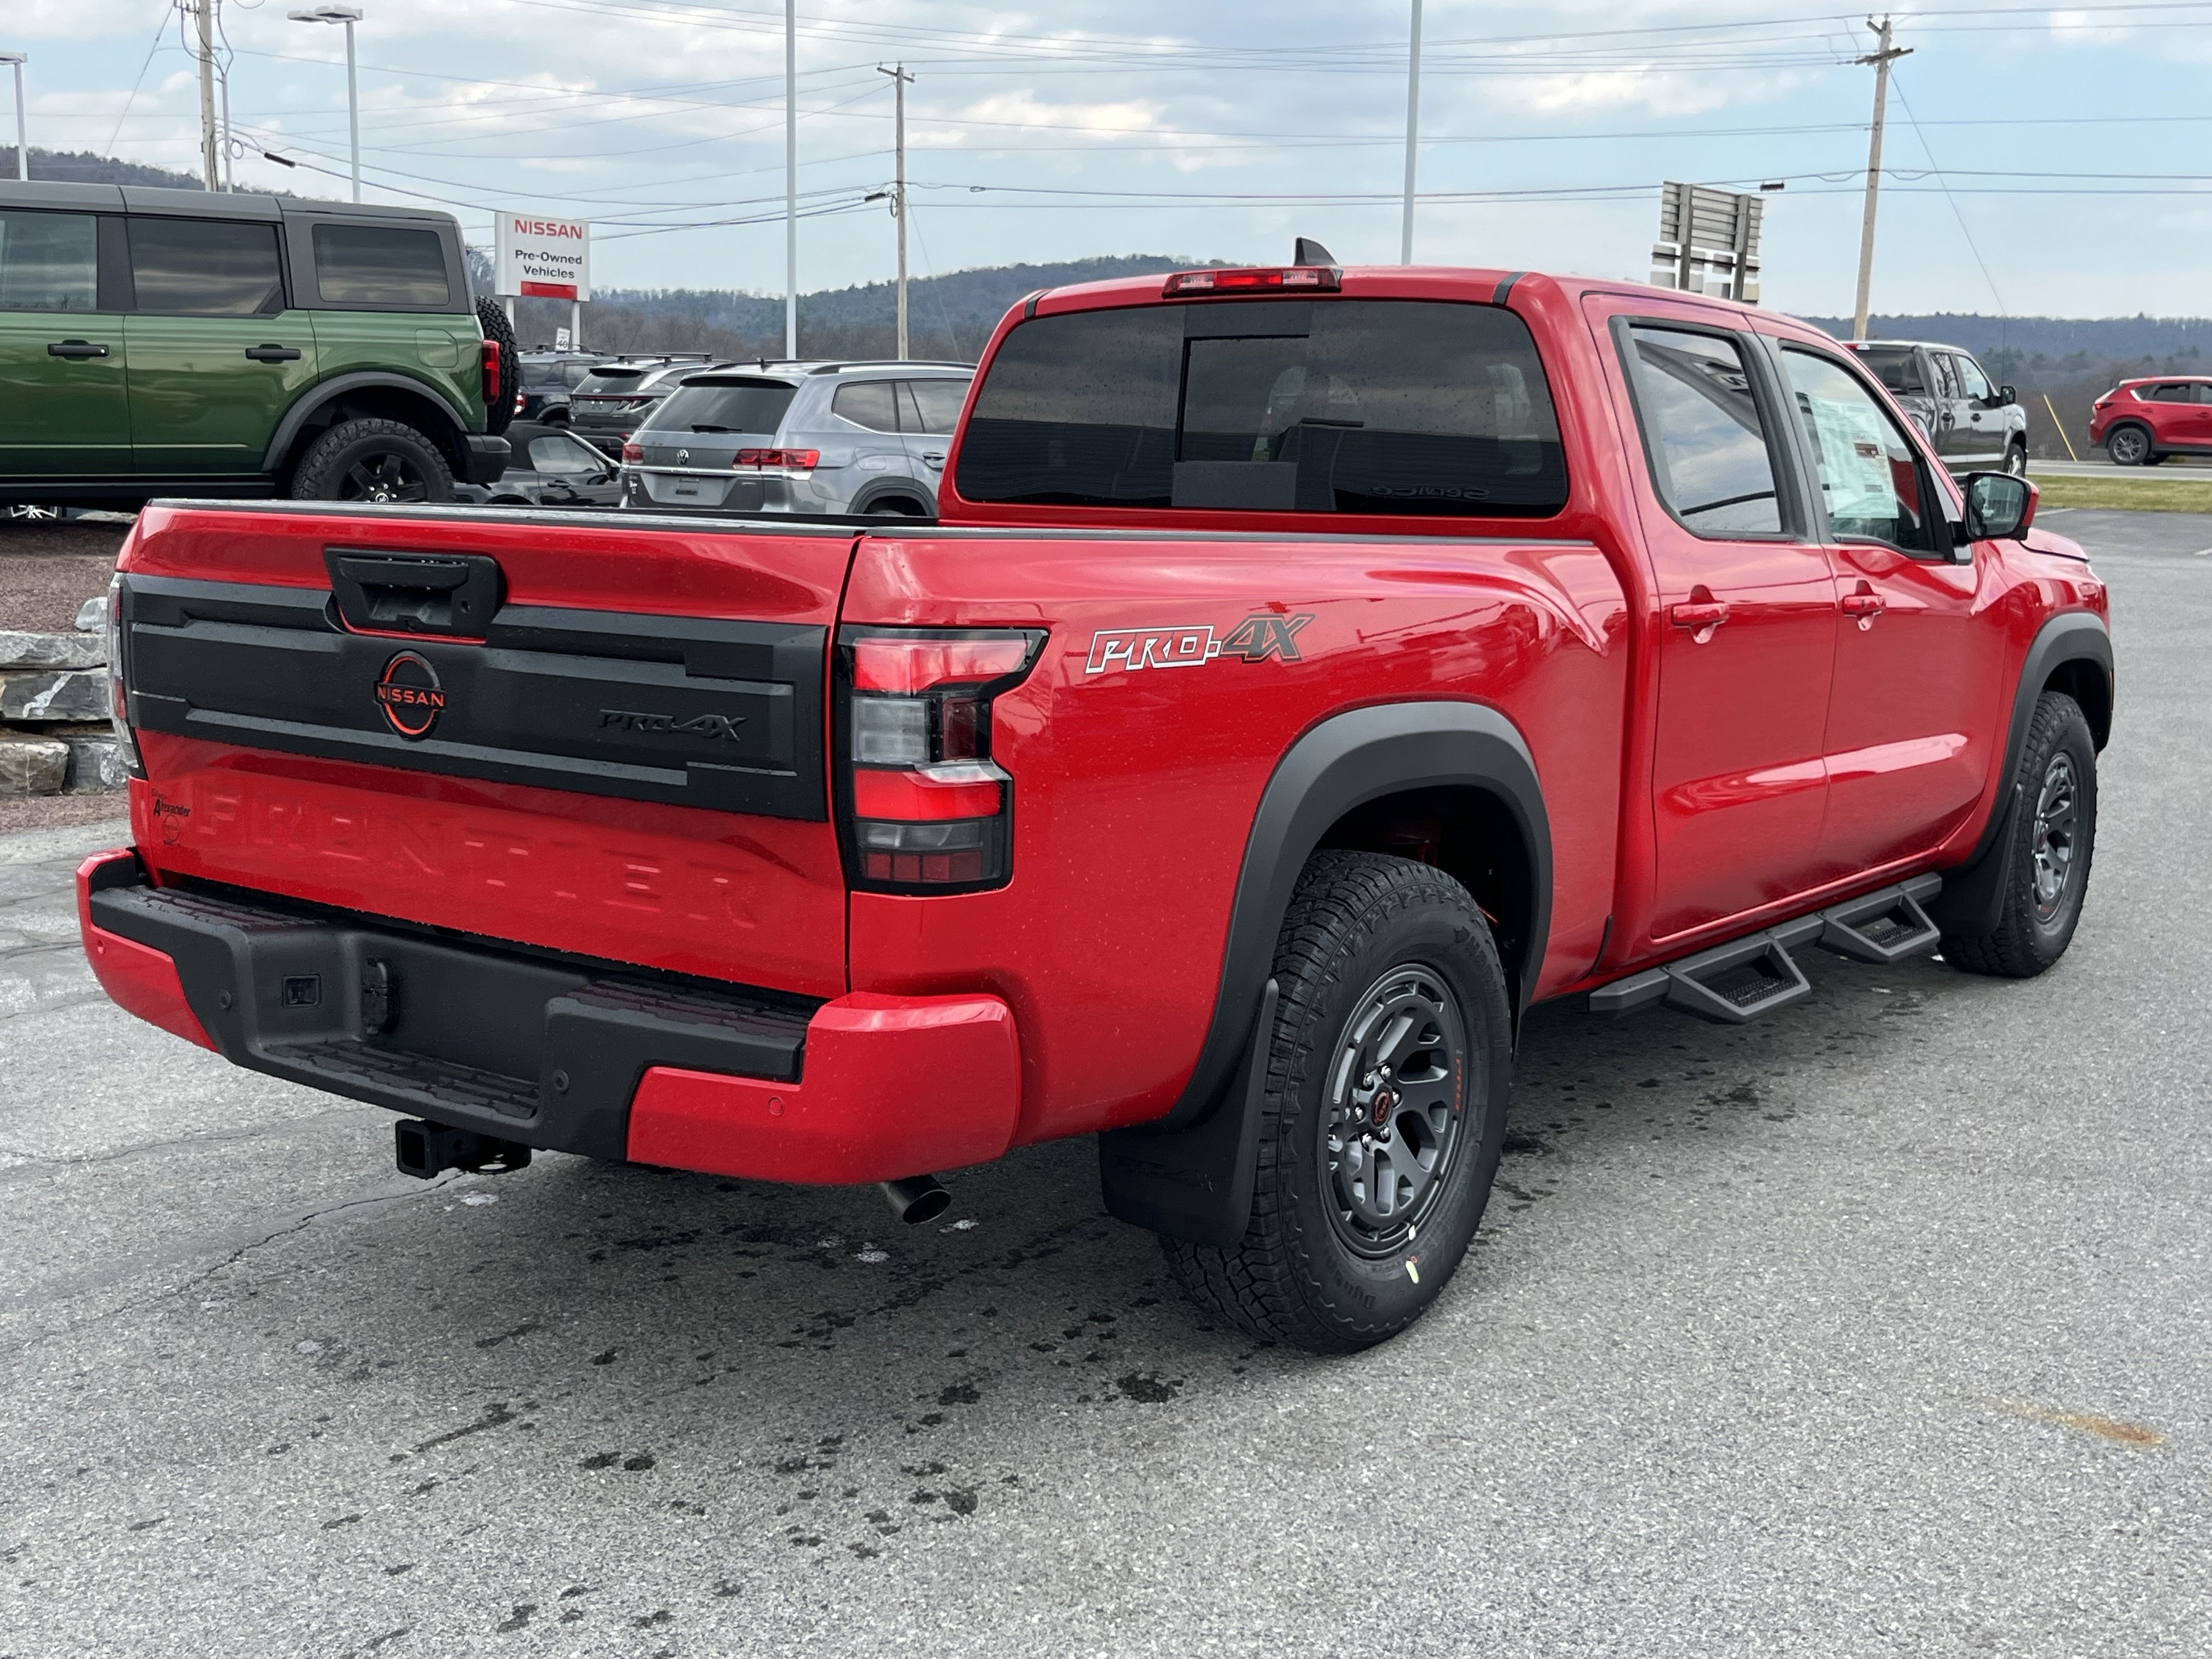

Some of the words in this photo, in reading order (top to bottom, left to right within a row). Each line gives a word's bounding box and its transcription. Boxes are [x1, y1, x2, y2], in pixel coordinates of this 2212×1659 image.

[515, 219, 582, 240] NISSAN
[515, 250, 582, 264] Pre-Owned
[523, 265, 574, 279] Vehicles
[377, 684, 445, 707] NISSAN
